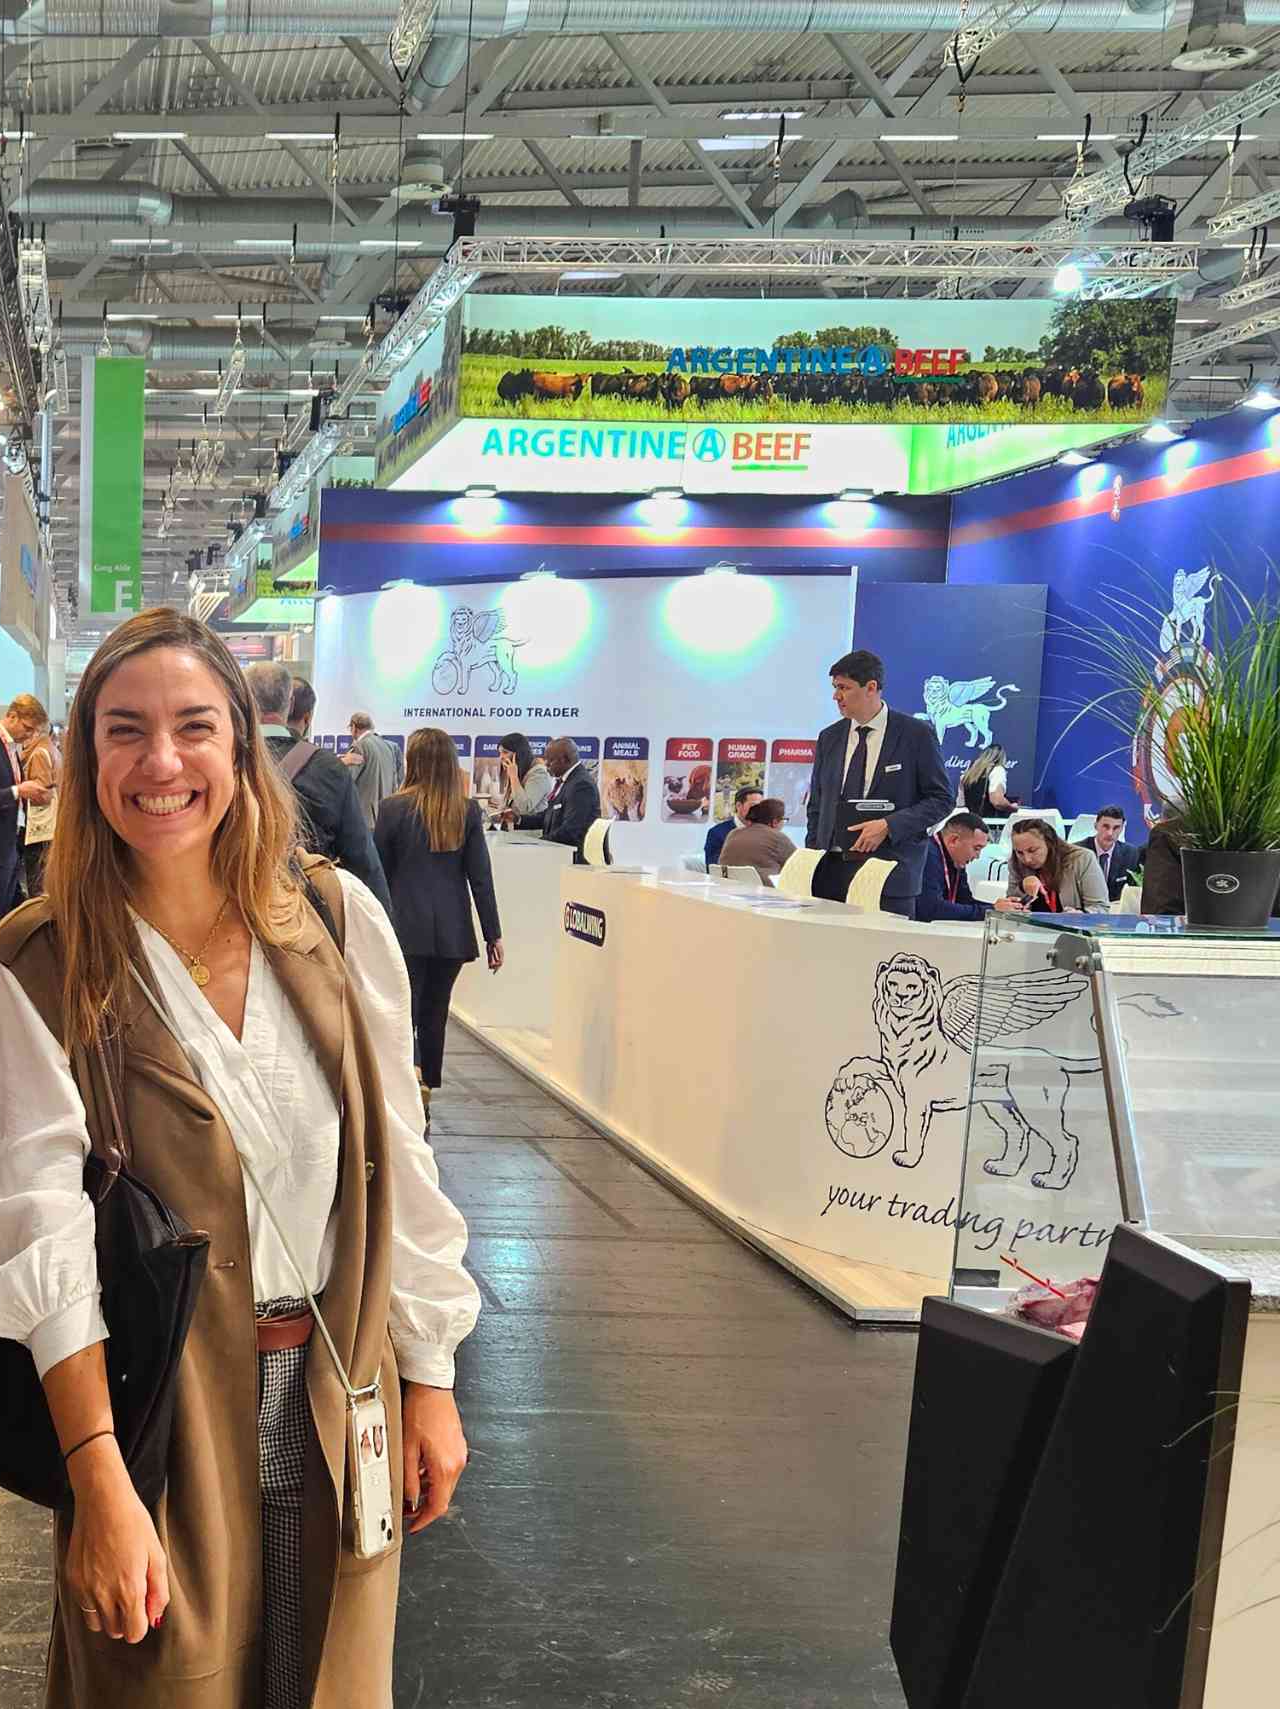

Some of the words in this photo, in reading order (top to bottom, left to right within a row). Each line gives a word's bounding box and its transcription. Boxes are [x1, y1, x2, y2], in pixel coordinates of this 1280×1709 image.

[665, 345, 856, 376] ARGENTINE
[894, 348, 969, 377] BEEF
[481, 427, 687, 462] ARGENTINE
[732, 432, 812, 461] BEEF
[115, 580, 133, 613] E
[403, 707, 486, 719] INTERNATIONAL
[489, 707, 523, 718] FOOD
[526, 707, 580, 718] TRADER
[678, 750, 701, 758] FOOD
[727, 751, 756, 759] GRADE
[778, 748, 813, 756] PHARMA
[822, 1184, 882, 1217] your
[1008, 1217, 1113, 1253] partn
